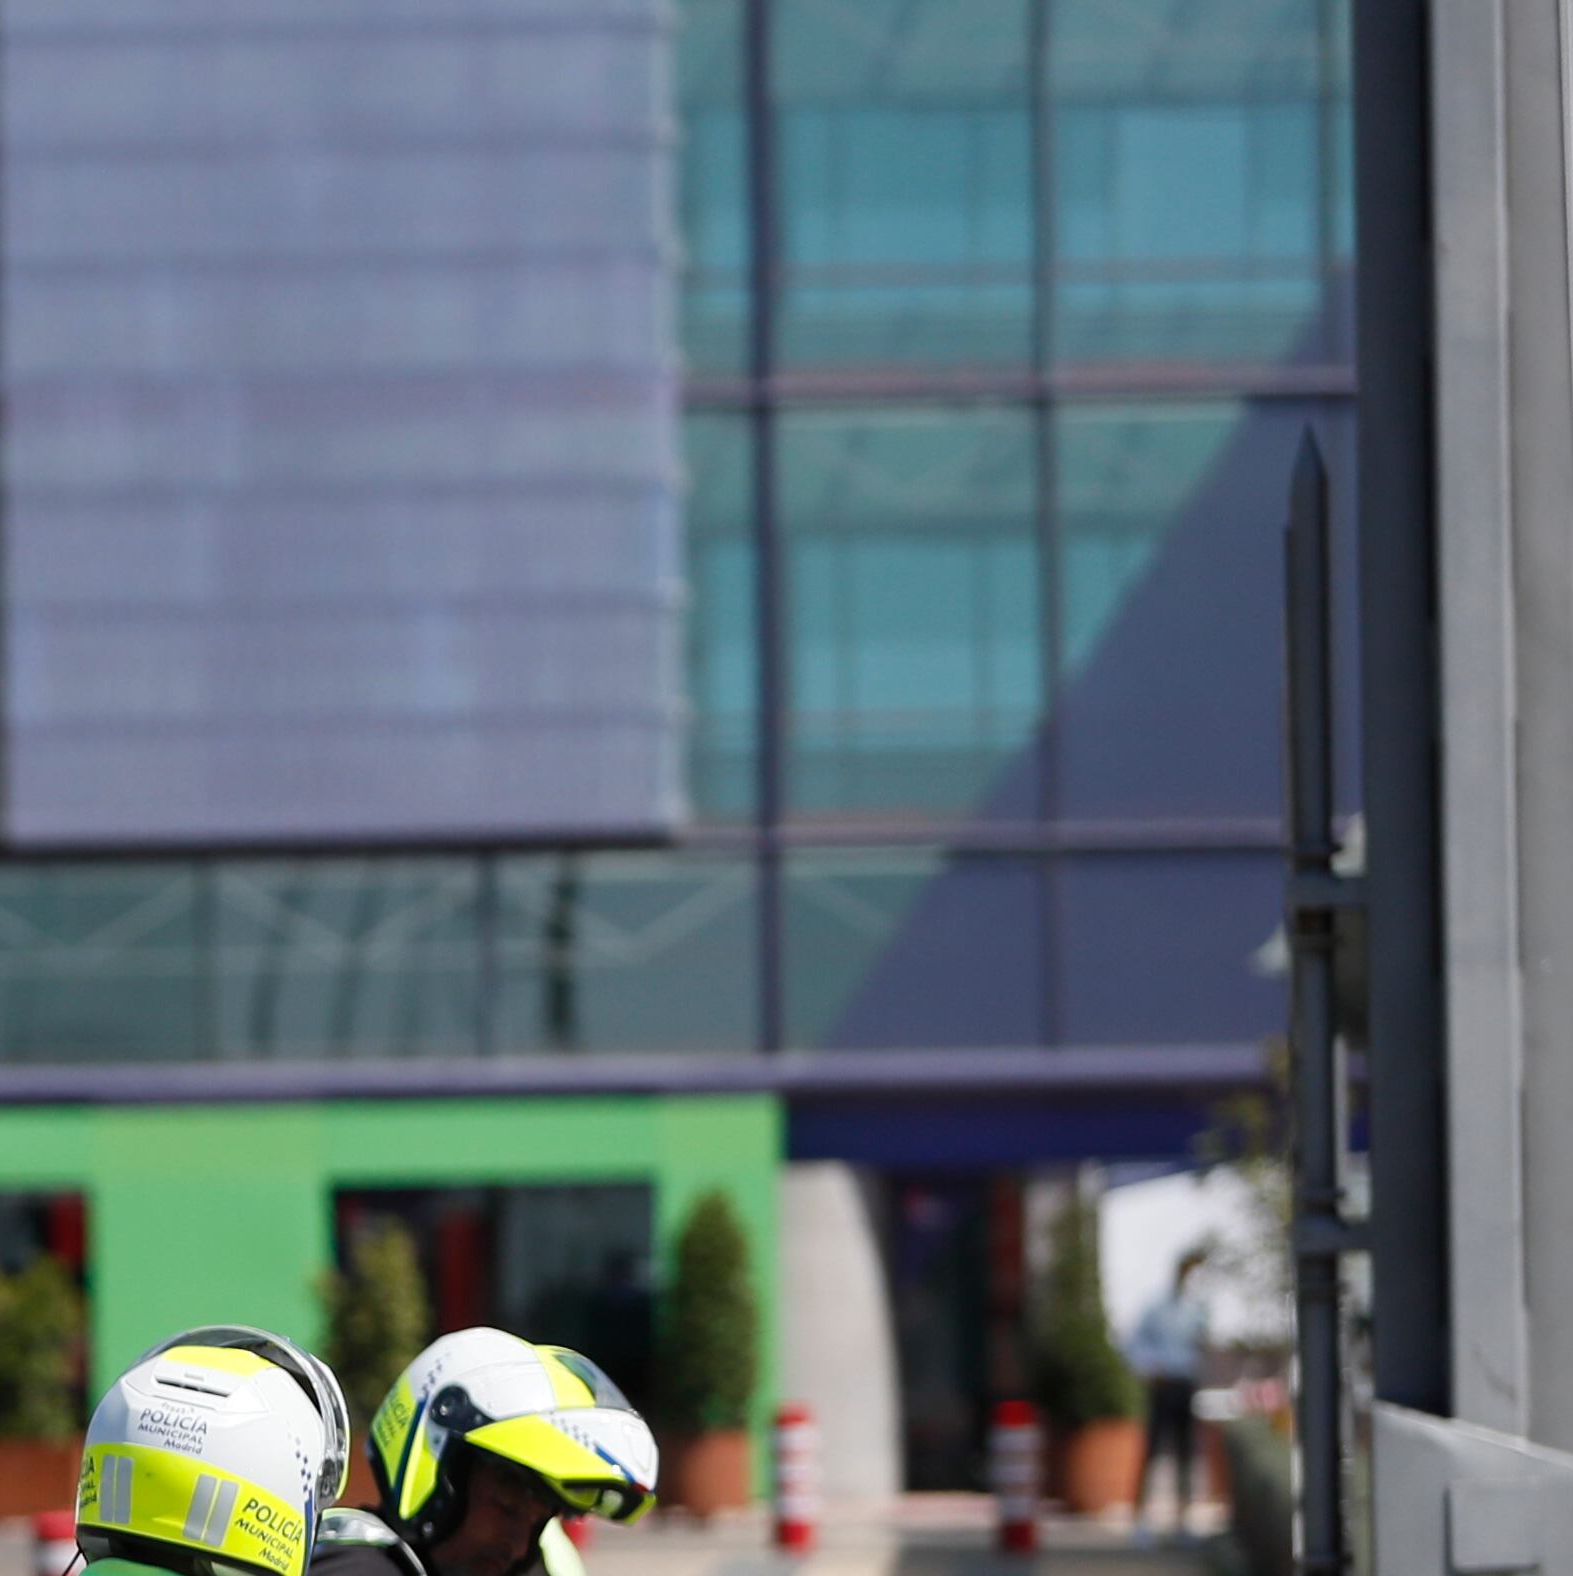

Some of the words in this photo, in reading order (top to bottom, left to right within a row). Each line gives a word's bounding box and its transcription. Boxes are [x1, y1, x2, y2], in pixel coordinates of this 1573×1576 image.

[137, 1422, 203, 1445] MUNICIPAL
[164, 1438, 202, 1454] Madrid
[233, 1516, 294, 1560] MUNICIPAL
[258, 1546, 290, 1571] Madrid
